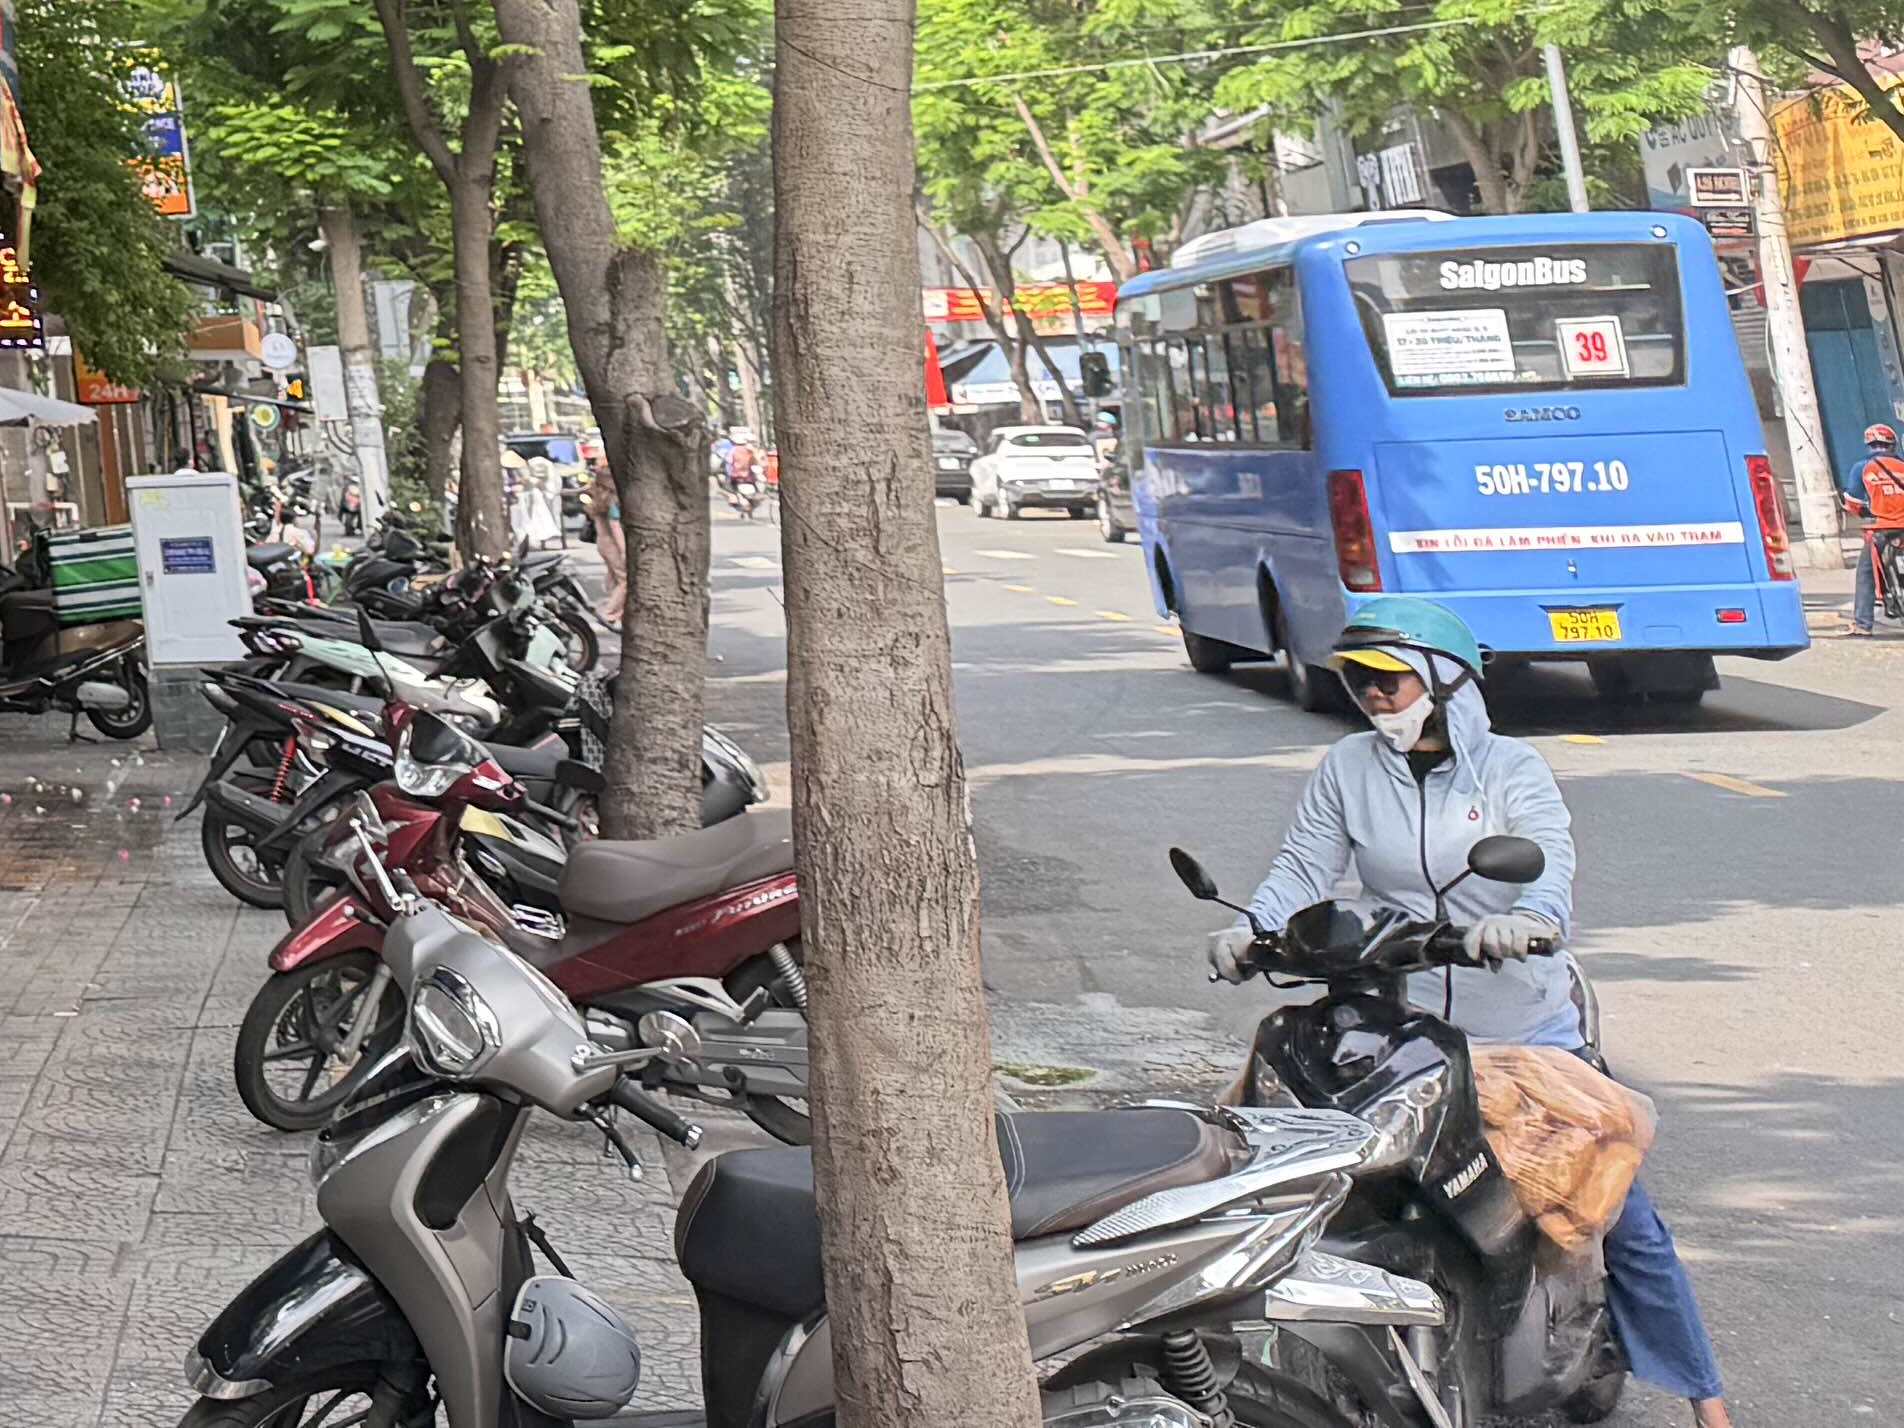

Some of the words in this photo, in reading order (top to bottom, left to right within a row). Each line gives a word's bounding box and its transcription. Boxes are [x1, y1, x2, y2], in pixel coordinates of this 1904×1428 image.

[1439, 256, 1588, 291] SaigonBus
[1574, 331, 1608, 362] 39
[1474, 459, 1630, 498] 50H-797.10
[1442, 1152, 1489, 1199] YAMAHA
